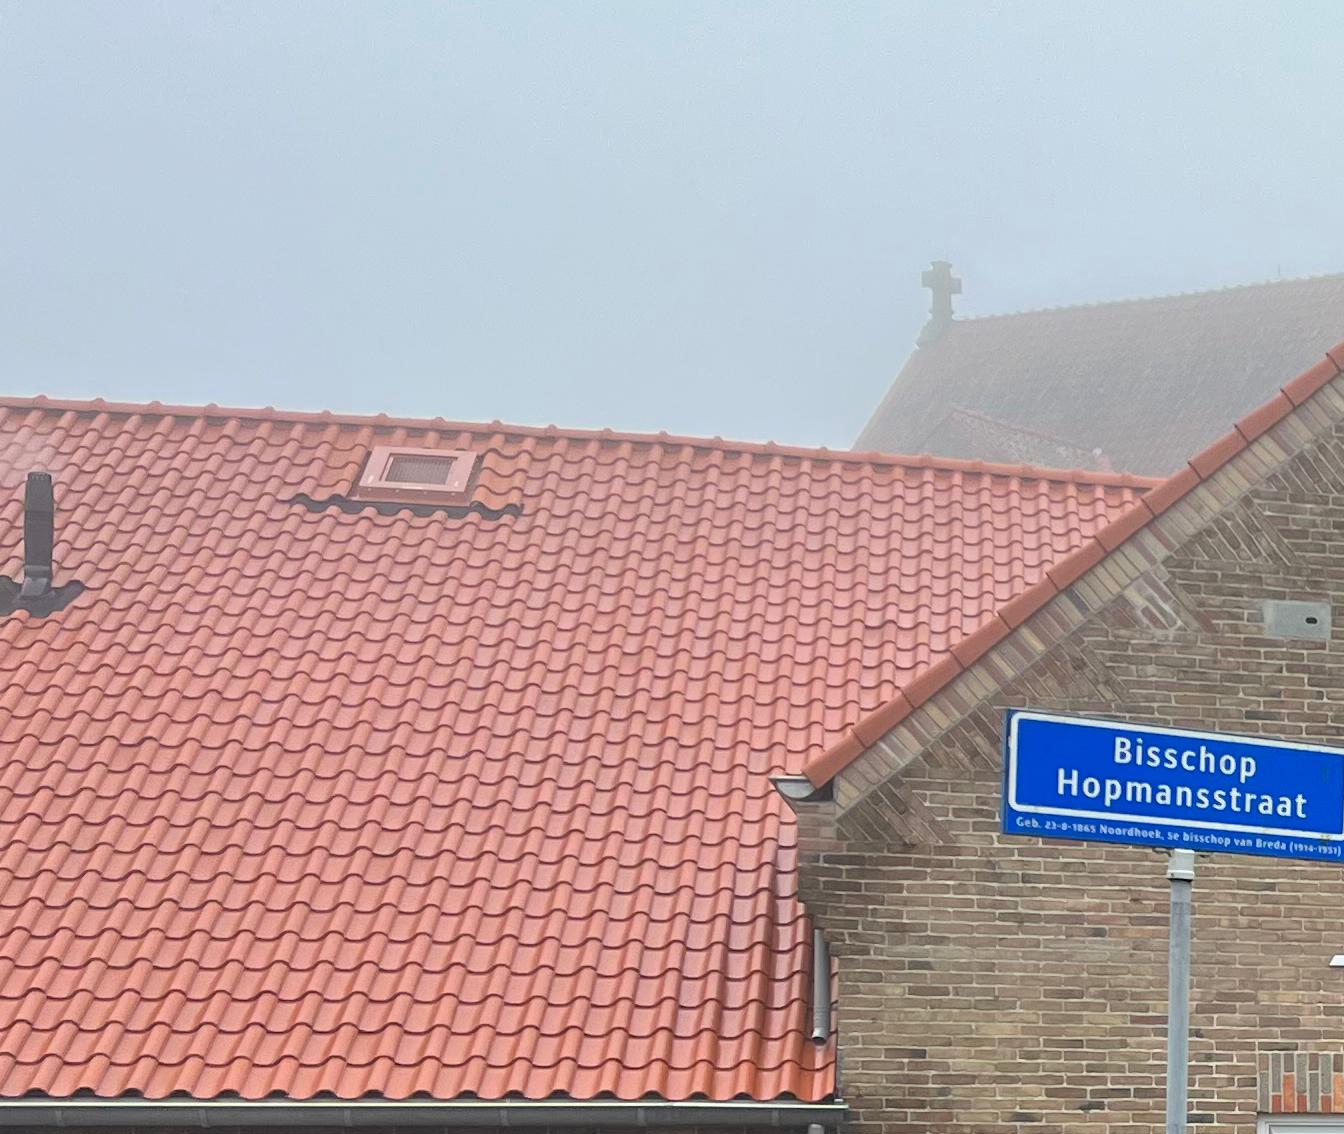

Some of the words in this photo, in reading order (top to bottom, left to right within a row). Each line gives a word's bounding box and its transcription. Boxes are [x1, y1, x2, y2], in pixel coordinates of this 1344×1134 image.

[1114, 737, 1257, 783] Bisschop
[1057, 768, 1307, 819] Hopmansstraat
[1016, 816, 1041, 829] Geb.
[1167, 831, 1180, 841] 5e
[1183, 832, 1230, 848] bisschop
[1233, 838, 1252, 847] van
[1255, 838, 1287, 850] Breda
